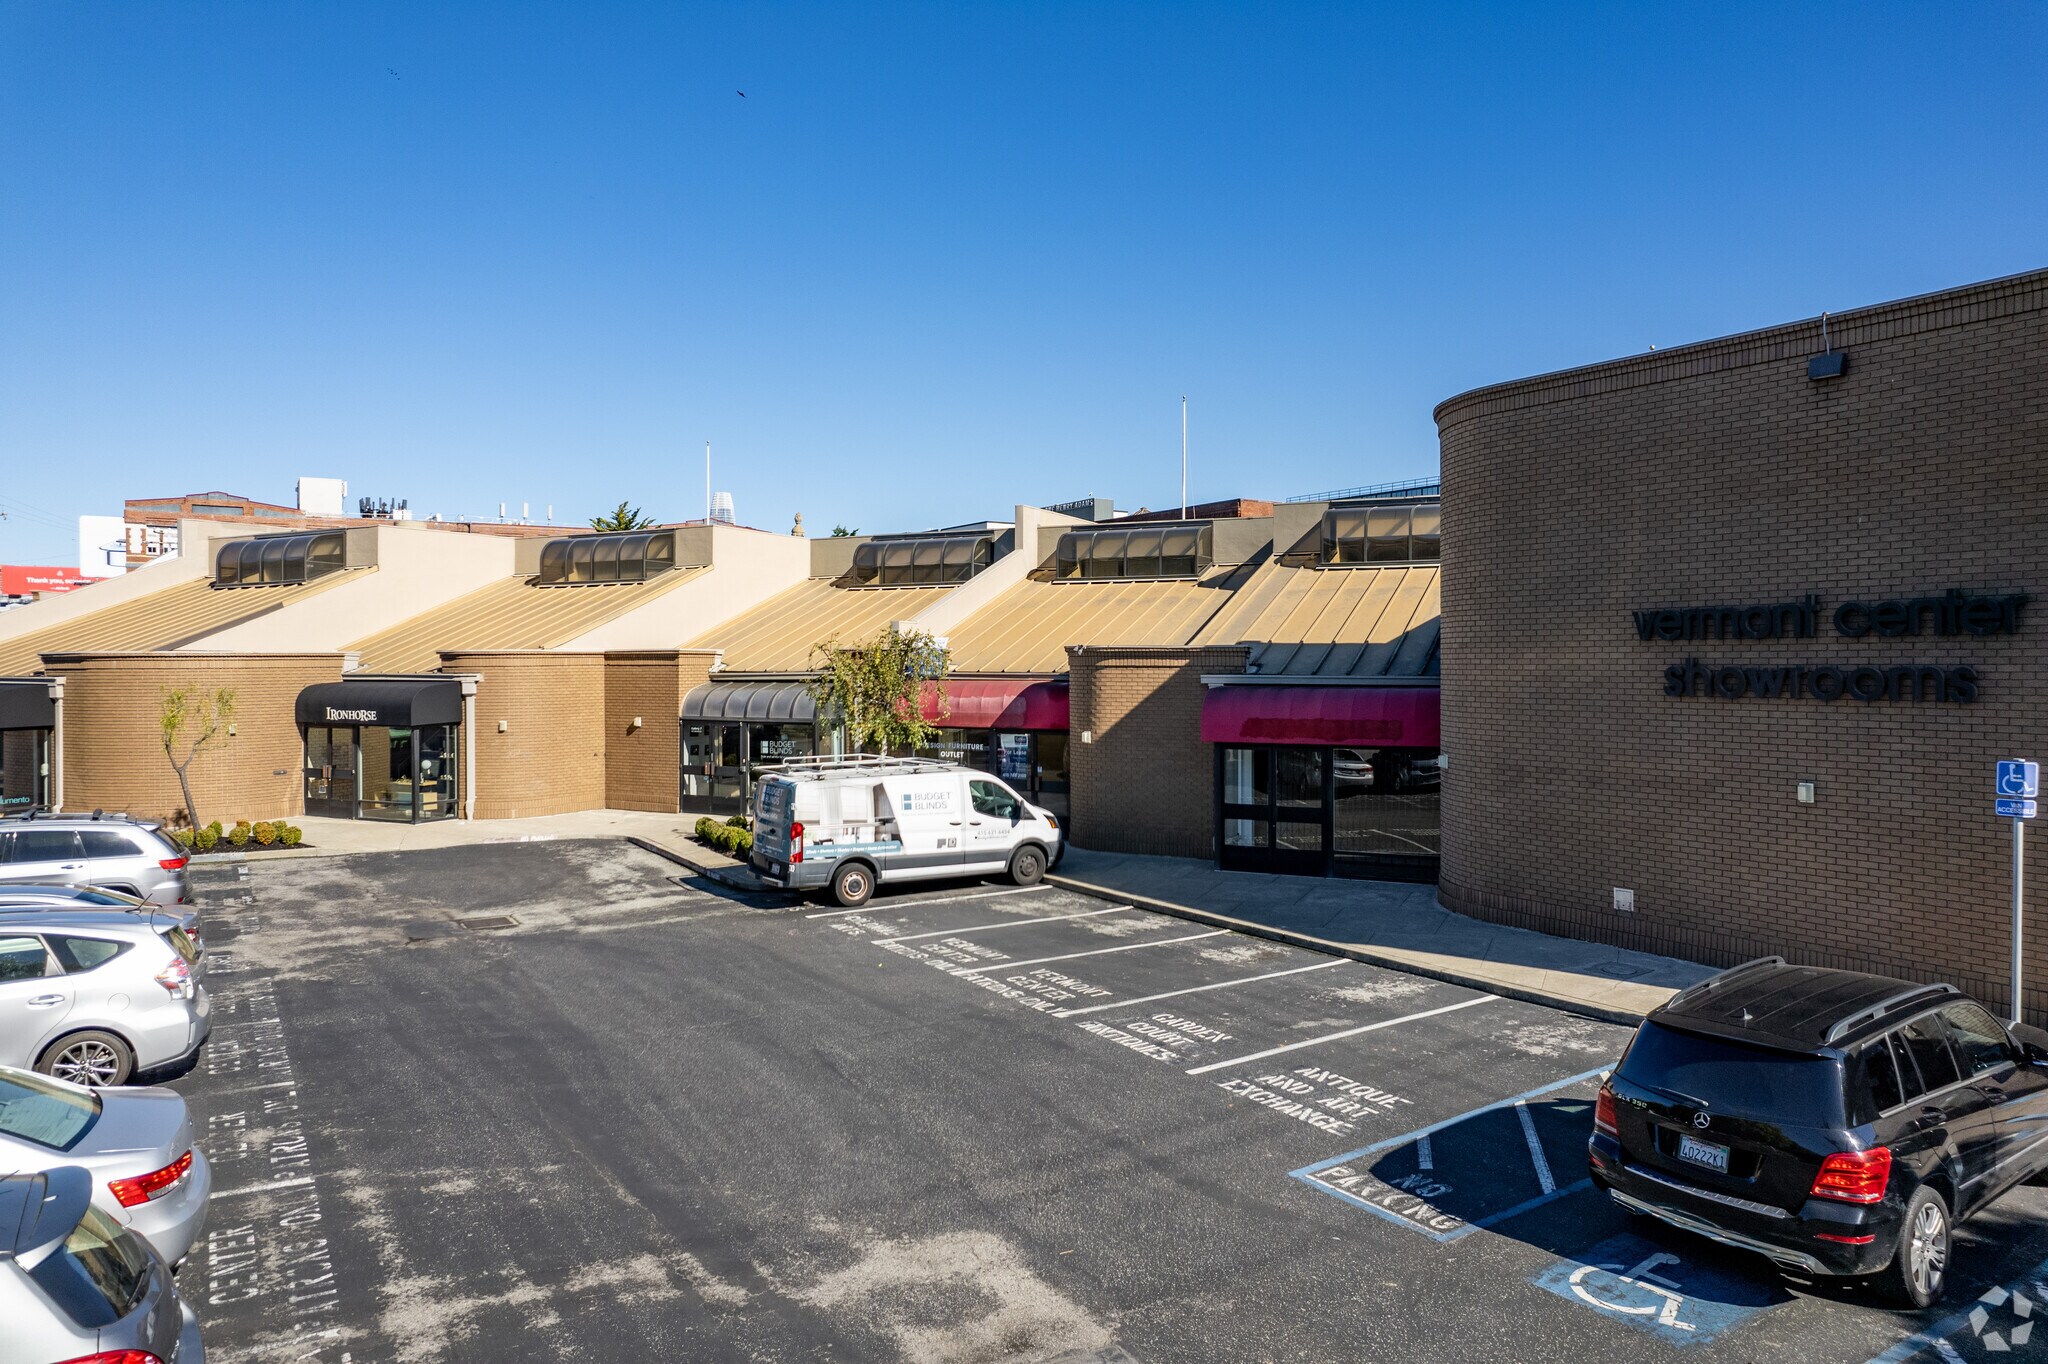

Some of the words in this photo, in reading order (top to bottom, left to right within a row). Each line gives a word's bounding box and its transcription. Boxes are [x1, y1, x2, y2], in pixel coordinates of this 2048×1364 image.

[1074, 499, 1093, 507] ADAMS
[1632, 593, 1820, 641] vermont
[1833, 587, 2029, 637] center
[1663, 657, 1979, 703] showrooms
[769, 748, 793, 756] BLINDS
[948, 742, 984, 751] FURNITURE
[914, 791, 951, 801] BUDGET
[914, 801, 948, 810] BLINDS
[920, 943, 978, 963] CENTER
[941, 937, 1011, 960] VERMONT
[1006, 975, 1076, 1001] CENTER
[1030, 968, 1113, 997] VERMONT
[1127, 1022, 1195, 1046] COURT
[1152, 1013, 1233, 1043] GARDEN
[1255, 1074, 1314, 1095] AND
[1294, 1067, 1415, 1109] ANTIQUE
[1216, 1079, 1354, 1137] EXCHANGE
[1316, 1097, 1380, 1118] ART
[1681, 1144, 1726, 1169] 40222K1
[1315, 1166, 1463, 1229] PARKING
[1391, 1173, 1453, 1198] NO
[208, 1224, 259, 1304] CENTER
